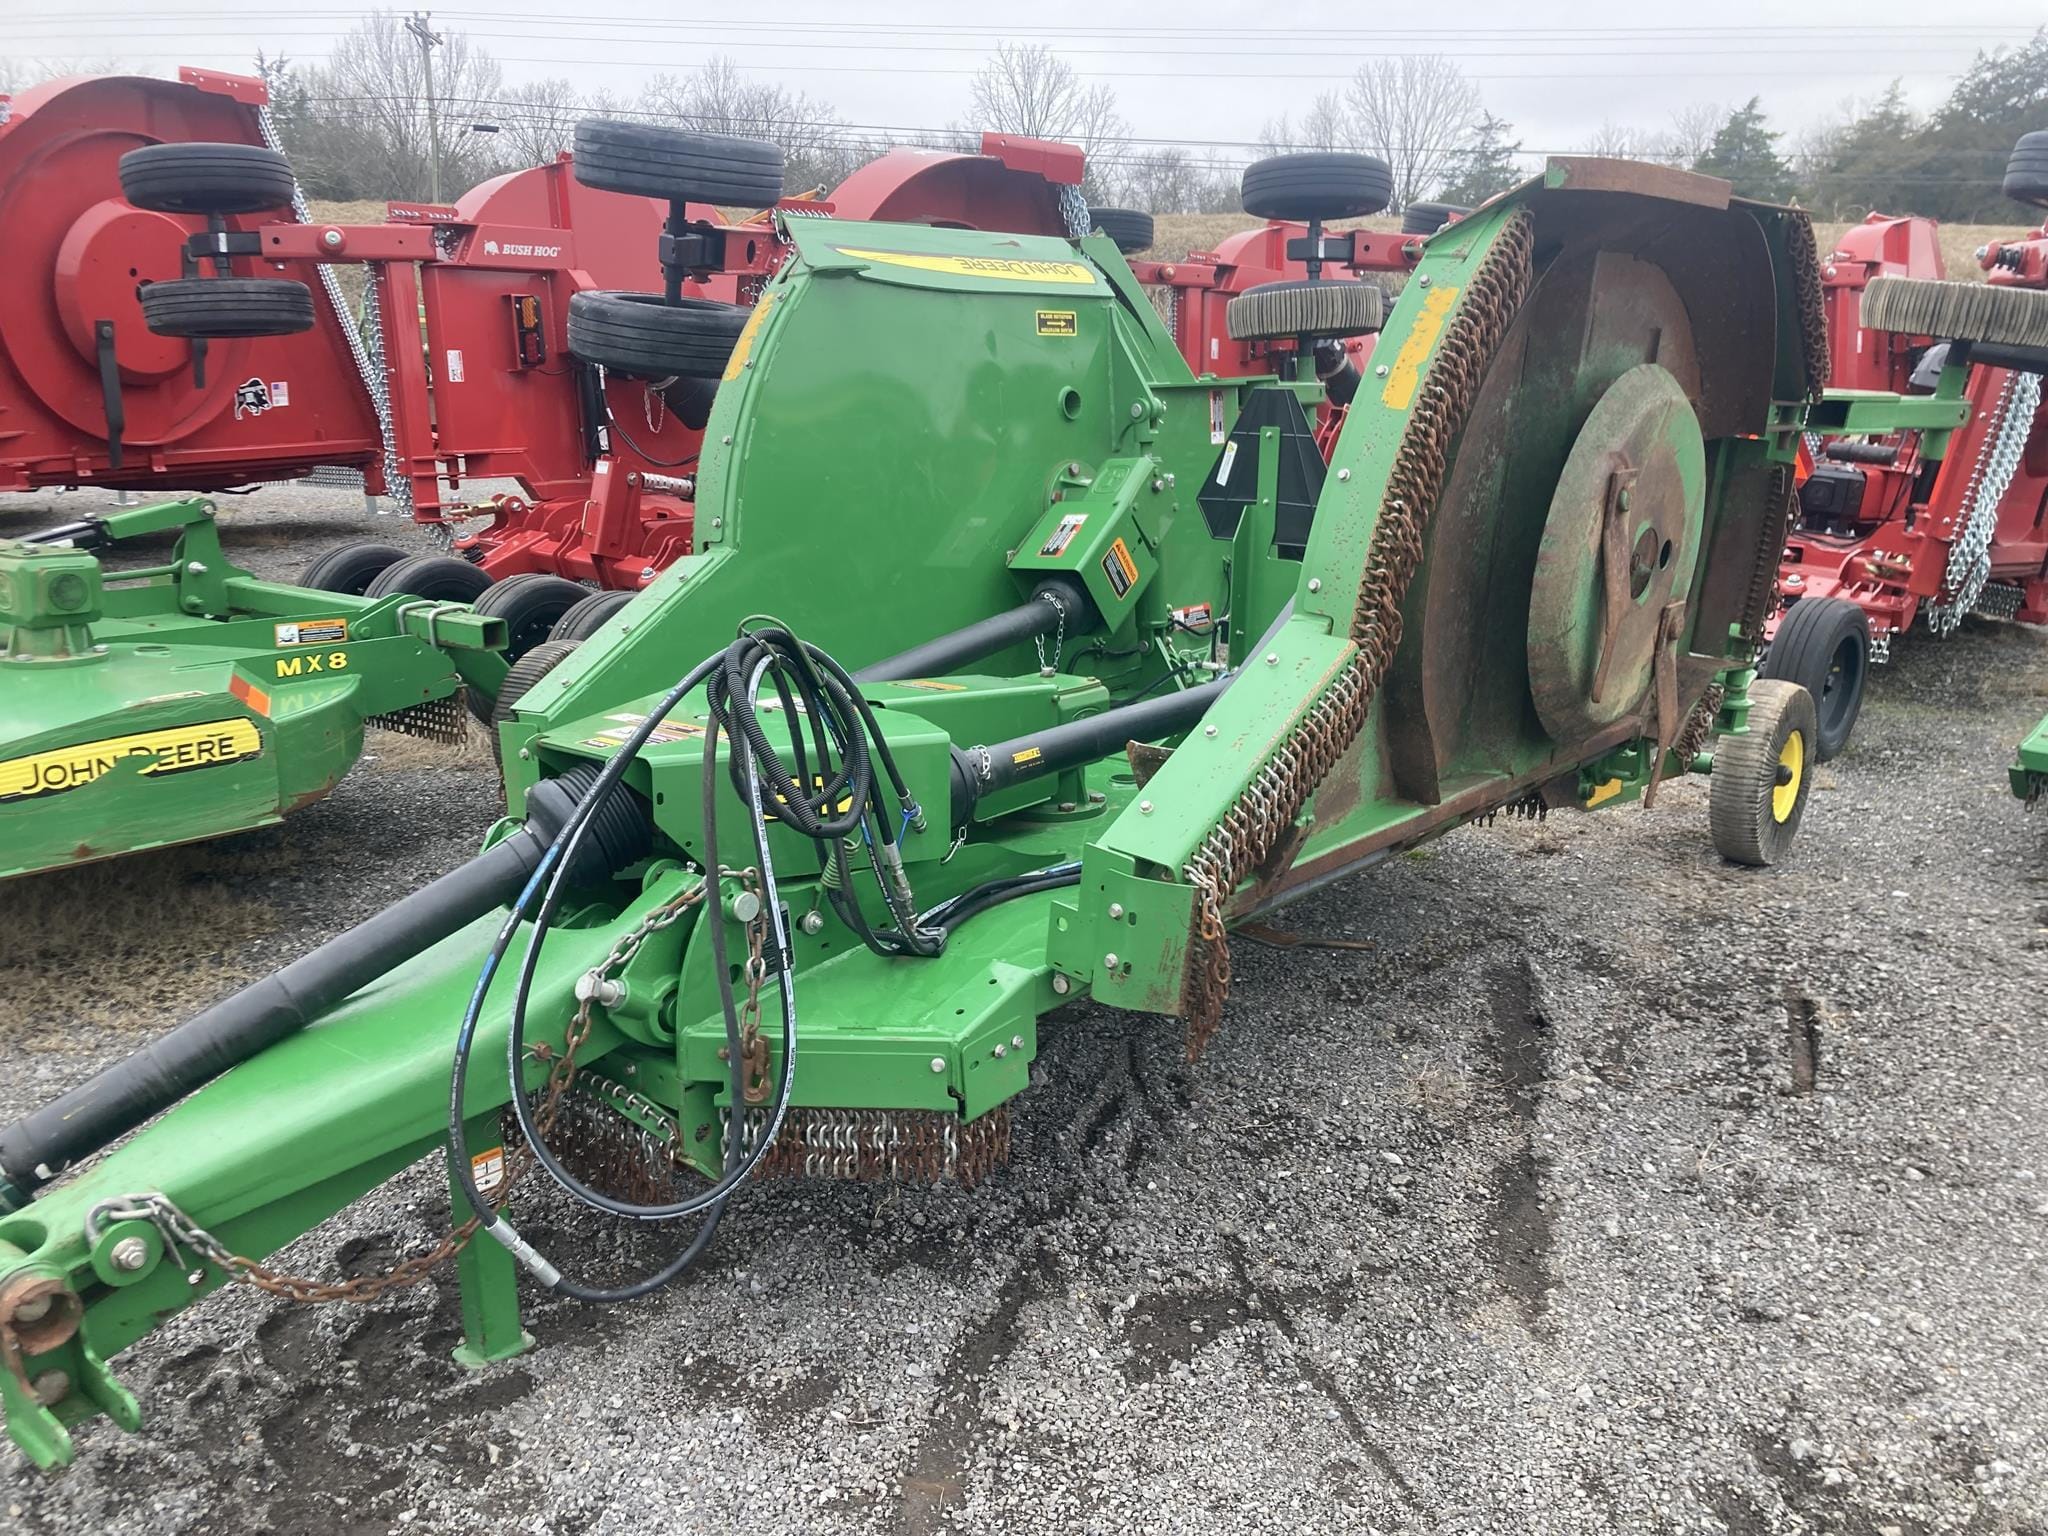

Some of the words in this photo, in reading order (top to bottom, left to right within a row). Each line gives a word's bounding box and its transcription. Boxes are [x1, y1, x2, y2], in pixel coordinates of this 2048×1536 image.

[502, 244, 532, 256] BUSH
[533, 246, 558, 257] HOG
[954, 259, 1029, 275] DEERE
[1023, 261, 1078, 278] JOHN
